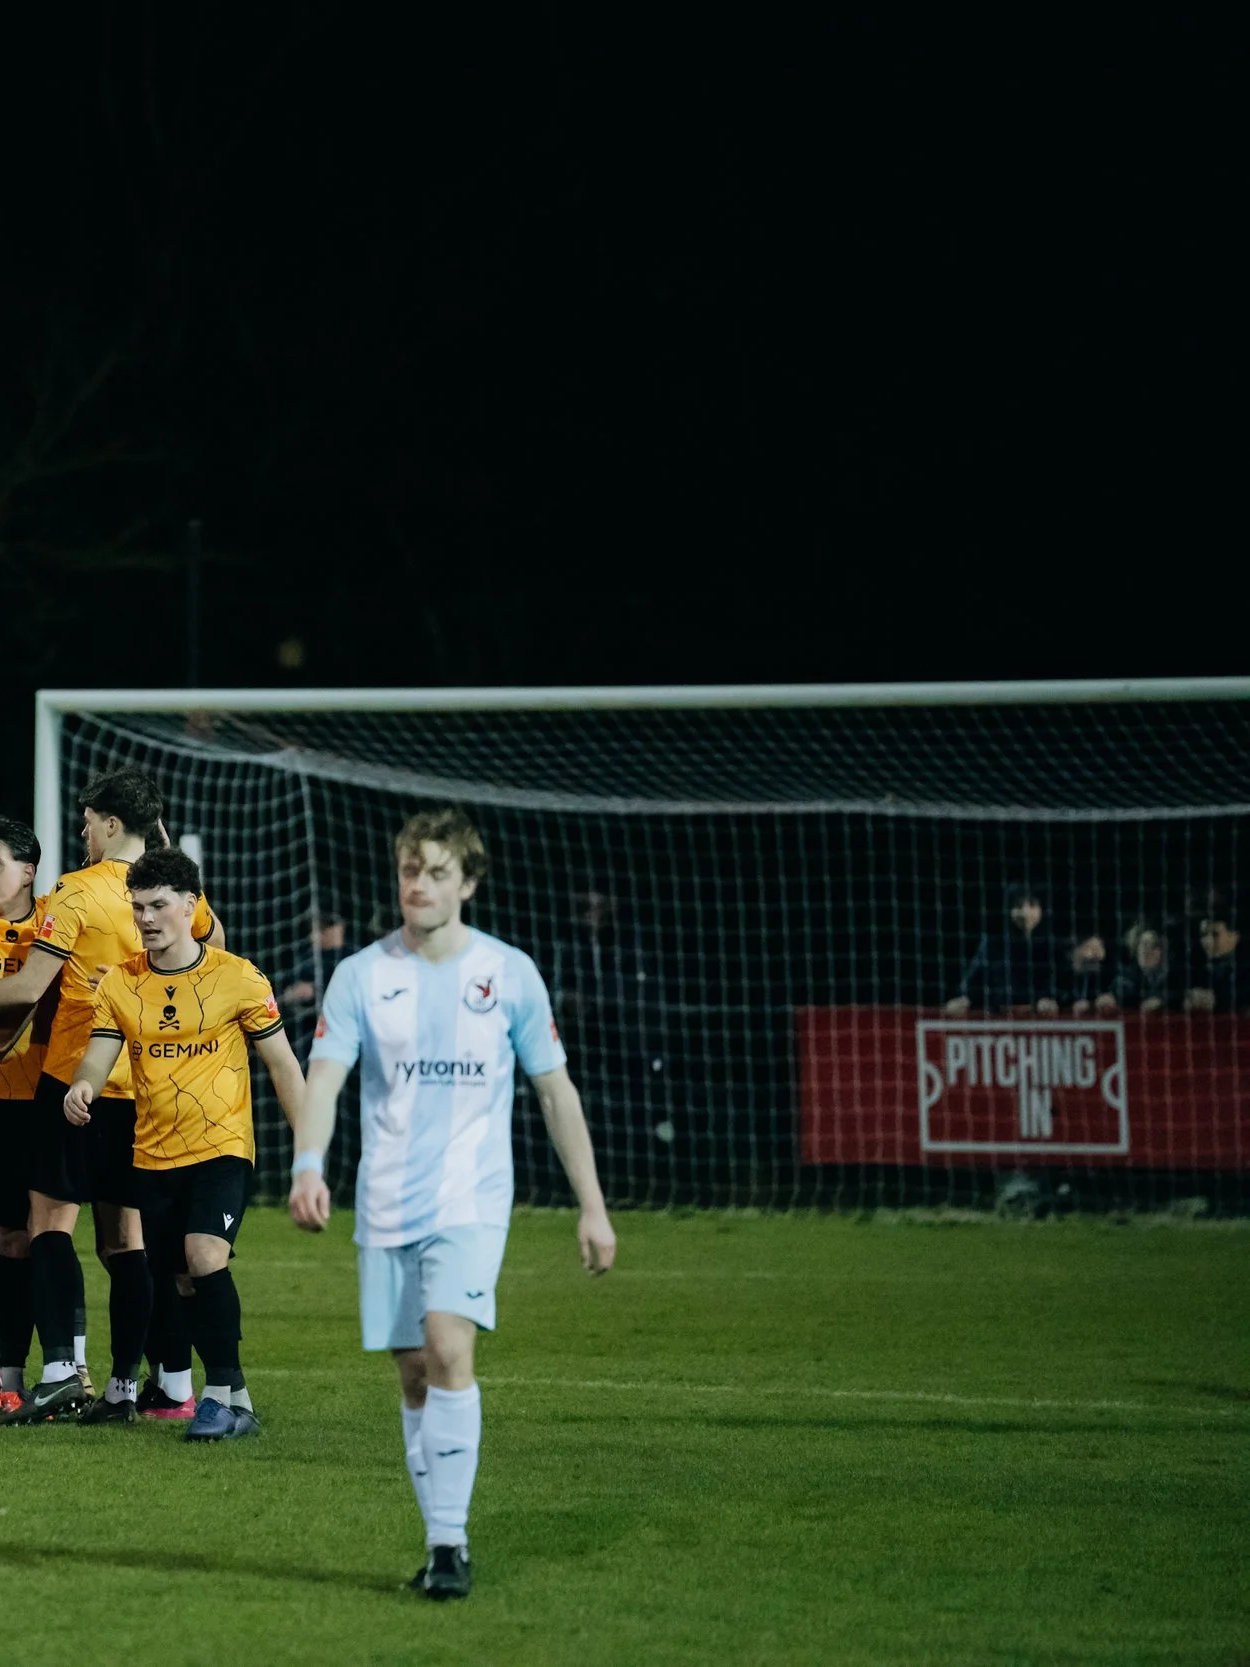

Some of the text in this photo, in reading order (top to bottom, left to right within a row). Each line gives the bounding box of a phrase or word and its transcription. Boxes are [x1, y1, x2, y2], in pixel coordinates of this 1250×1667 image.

[148, 1039, 219, 1059] GEMINI
[946, 1035, 1096, 1088] PITCHING
[1018, 1086, 1053, 1138] IN
